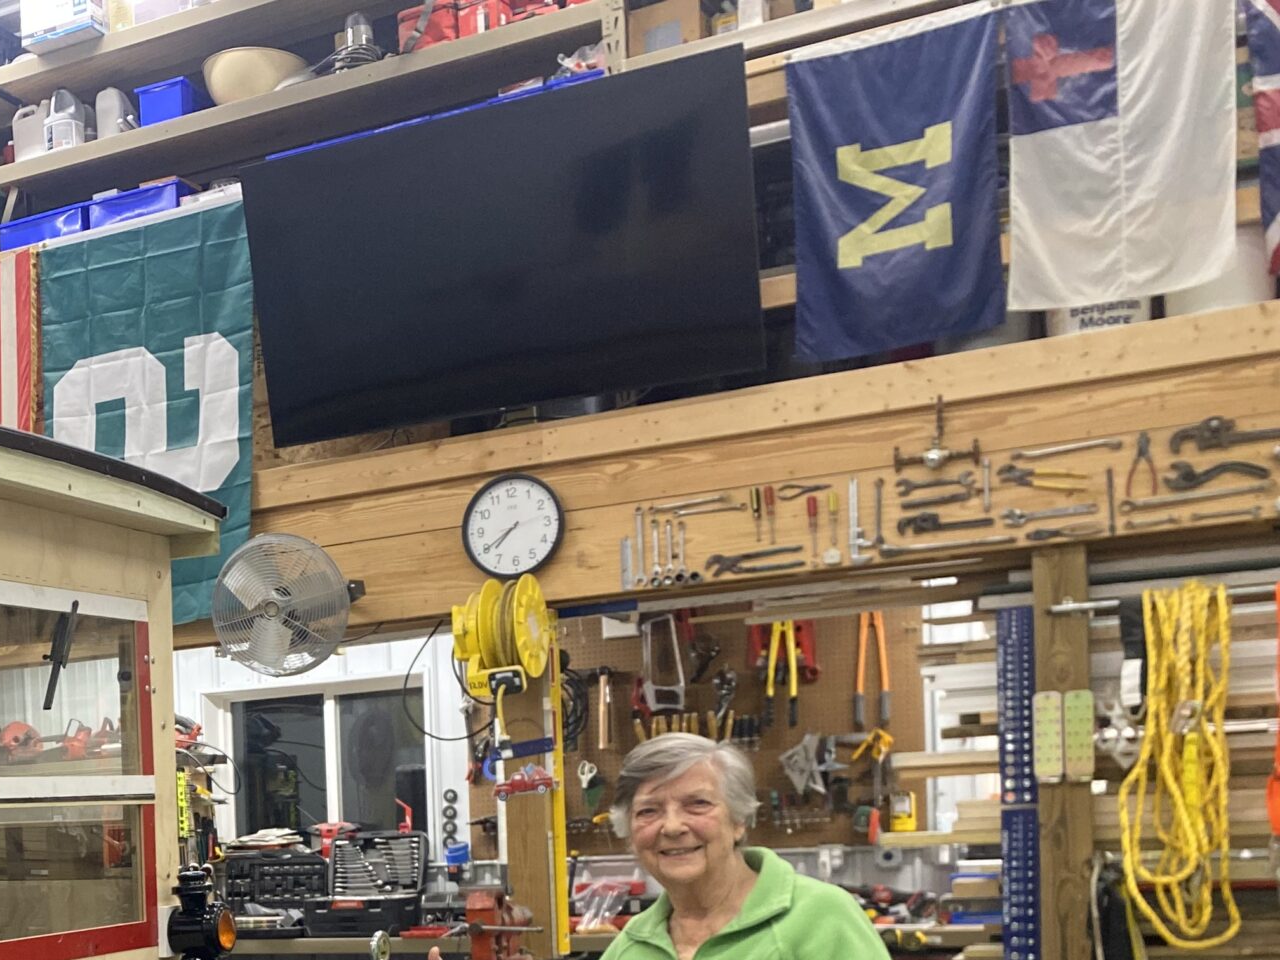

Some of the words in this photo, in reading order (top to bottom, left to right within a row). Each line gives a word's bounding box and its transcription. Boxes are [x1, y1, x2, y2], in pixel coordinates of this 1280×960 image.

[836, 120, 953, 270] M
[1079, 314, 1133, 329] Moore
[505, 486, 518, 498] 12
[490, 495, 500, 506] 11
[537, 499, 545, 511] 2
[479, 509, 491, 521] 10
[543, 515, 552, 527] 3
[477, 527, 485, 538] 9
[540, 533, 548, 544] 4
[495, 553, 503, 565] 7
[528, 548, 537, 560] 5
[512, 555, 520, 567] 6
